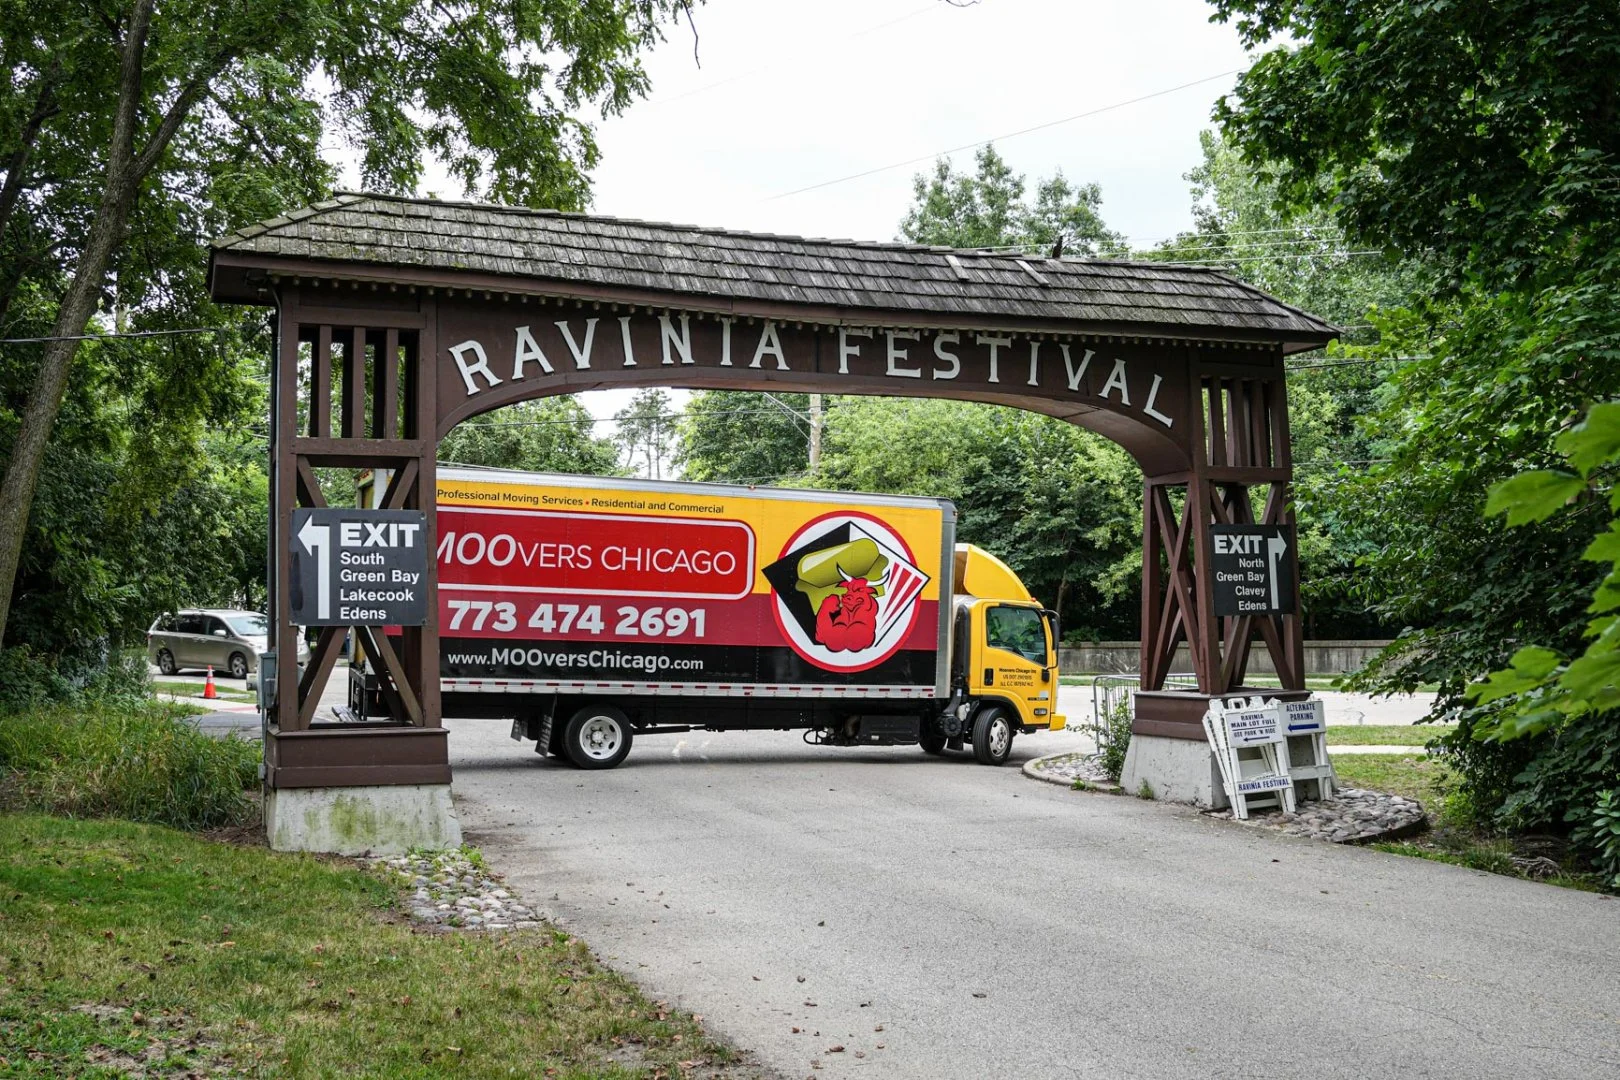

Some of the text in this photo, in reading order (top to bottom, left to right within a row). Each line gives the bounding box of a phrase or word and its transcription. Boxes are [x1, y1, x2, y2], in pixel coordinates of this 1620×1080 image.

[449, 315, 1174, 428] RAVINIA FESTIVAL
[437, 489, 724, 513] Professional Moving Services Residential and Commercial
[340, 522, 420, 547] EXIT
[1213, 534, 1263, 554] EXIT
[340, 551, 385, 565] South
[600, 546, 736, 575] CHICAGO
[1239, 558, 1264, 568] North
[340, 569, 420, 584] Green Bay
[1216, 571, 1265, 583] Green Bay
[340, 588, 414, 601] Lakecook
[1235, 586, 1266, 597] Clavey
[340, 606, 387, 620] Edens
[1238, 601, 1267, 611] Edens
[447, 600, 706, 637] 773 474 2691
[447, 647, 704, 673] www.MOOversChicago.com
[1286, 704, 1315, 712] ALTERNATE
[1290, 712, 1314, 721] PARKING
[1238, 778, 1289, 791] RAVINIA FESTIVAL
